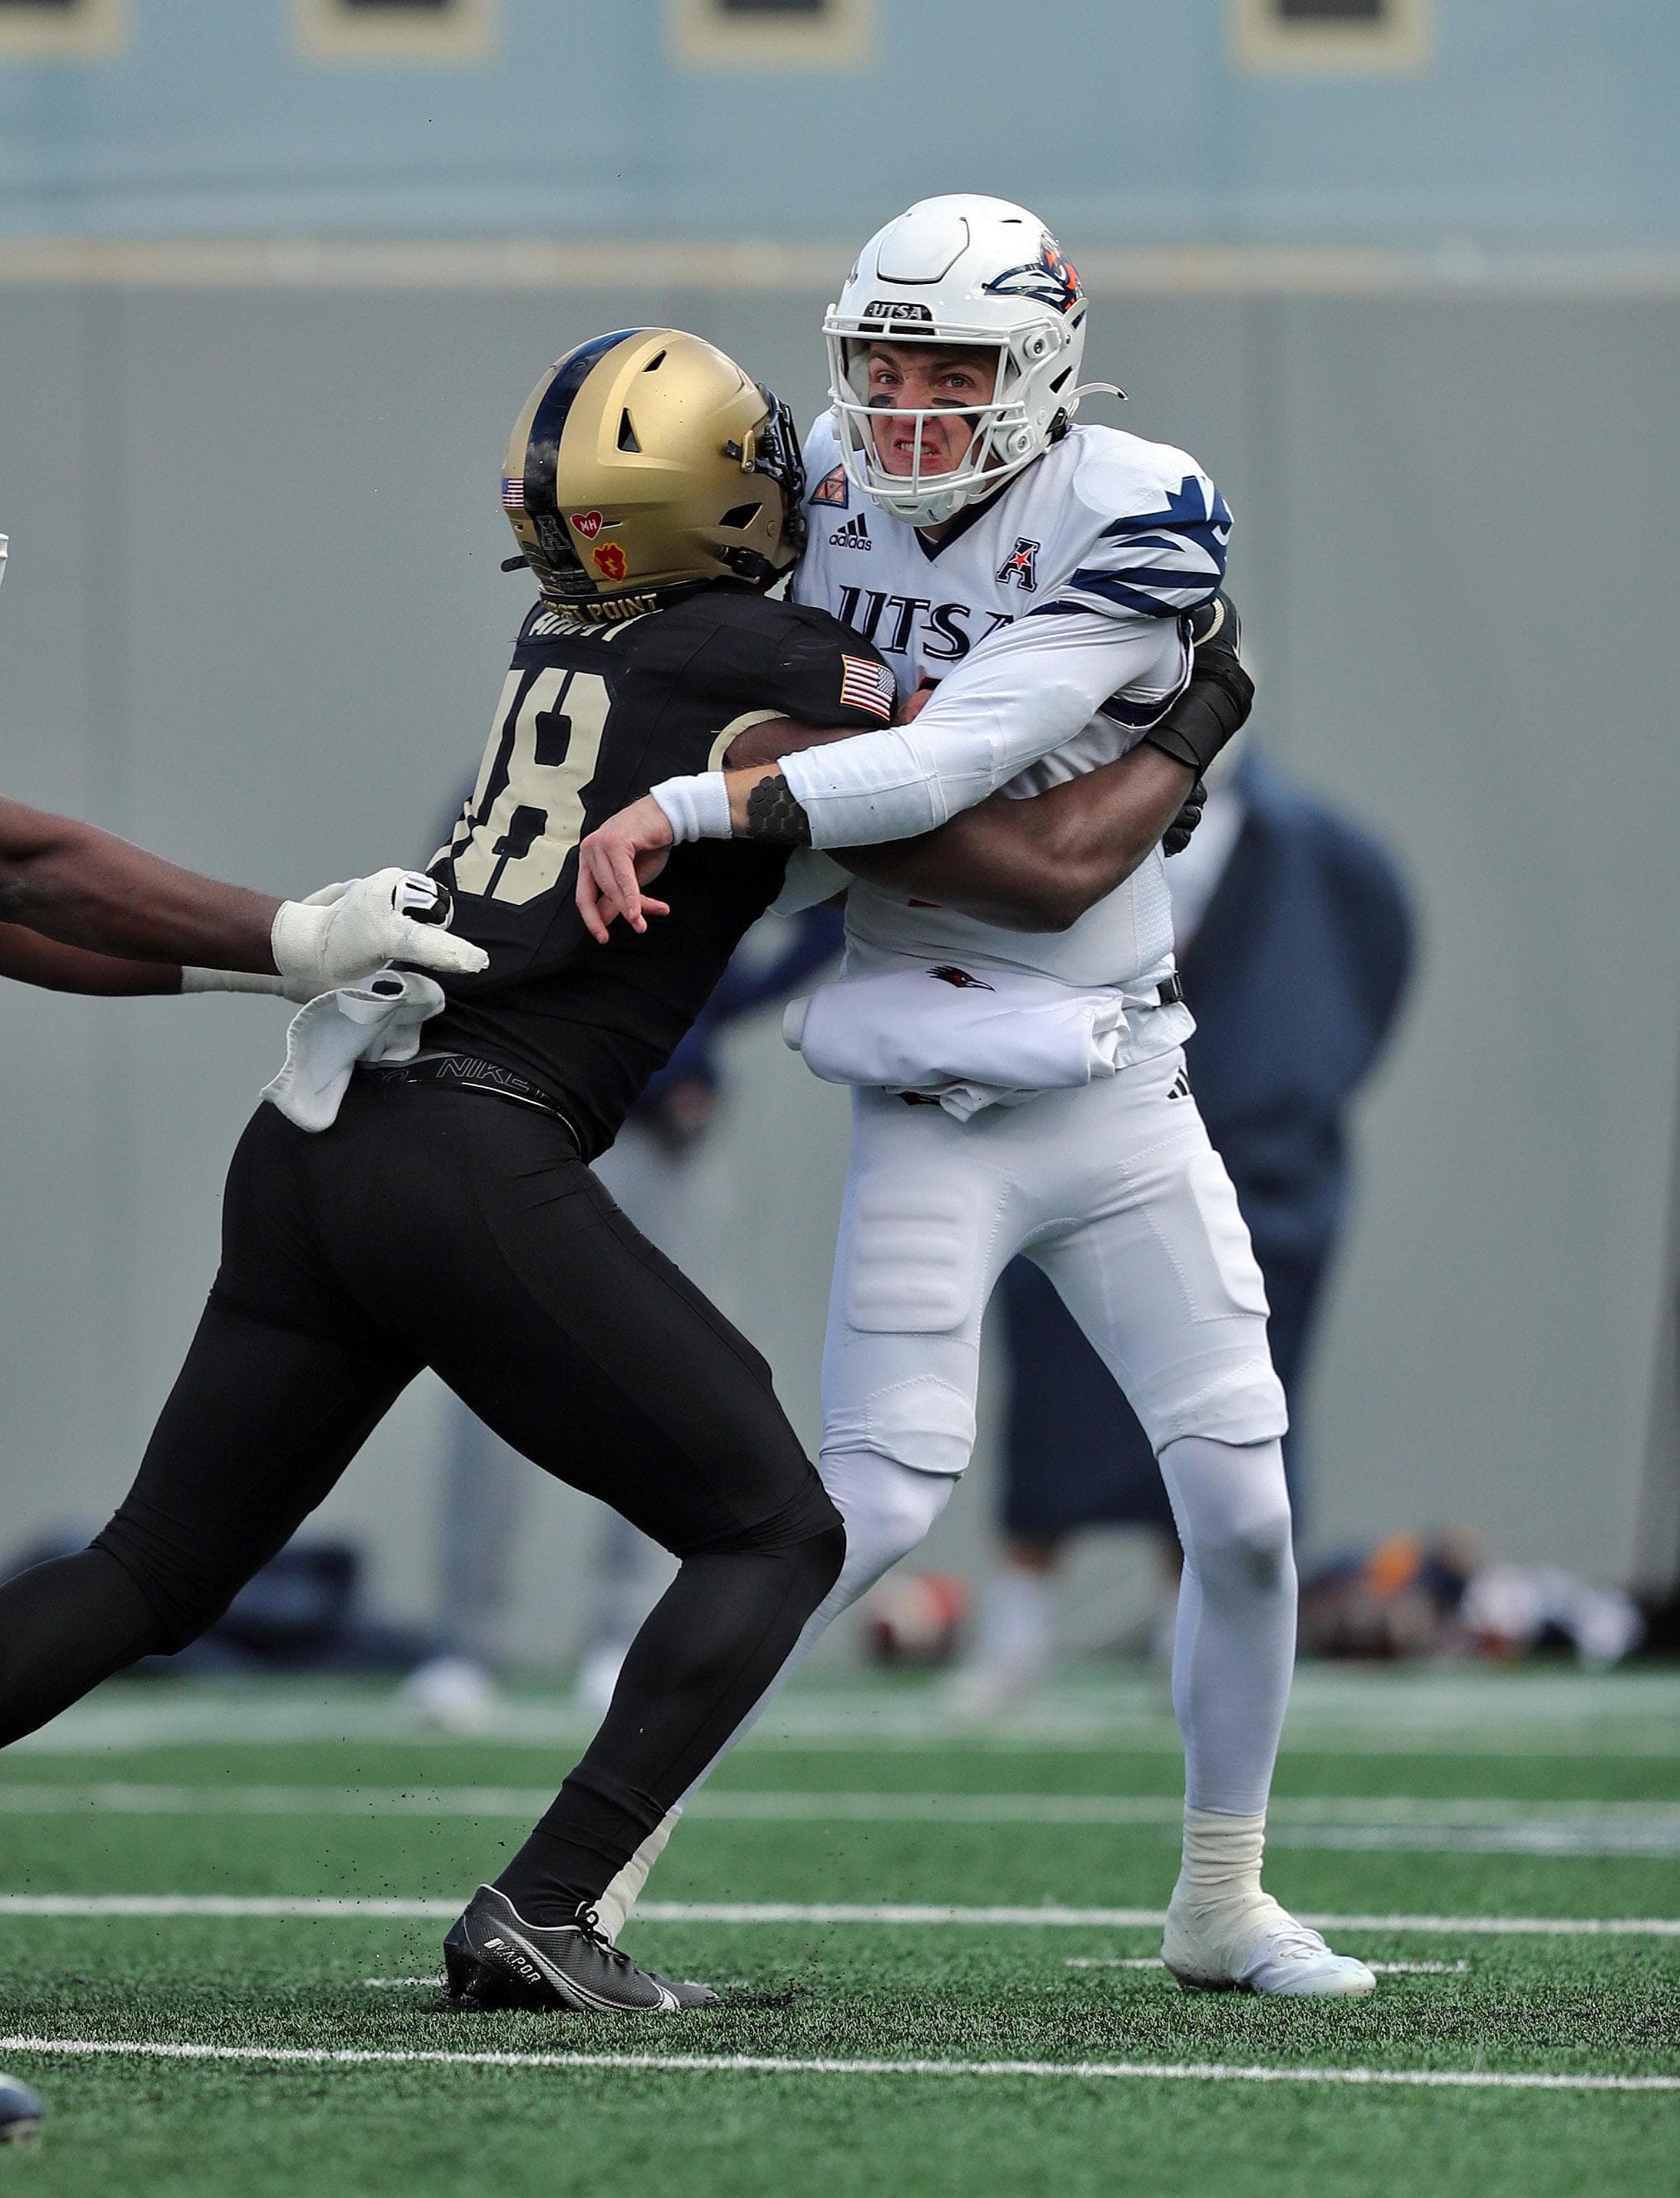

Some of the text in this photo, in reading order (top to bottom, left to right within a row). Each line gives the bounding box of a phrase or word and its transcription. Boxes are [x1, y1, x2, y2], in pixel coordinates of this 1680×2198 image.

[872, 303, 923, 321] UTSA
[580, 519, 598, 532] MH
[829, 534, 873, 551] adidas
[996, 536, 1041, 593] A
[586, 592, 658, 623] POINT
[425, 666, 612, 907] 18
[436, 1057, 531, 1093] NIKE
